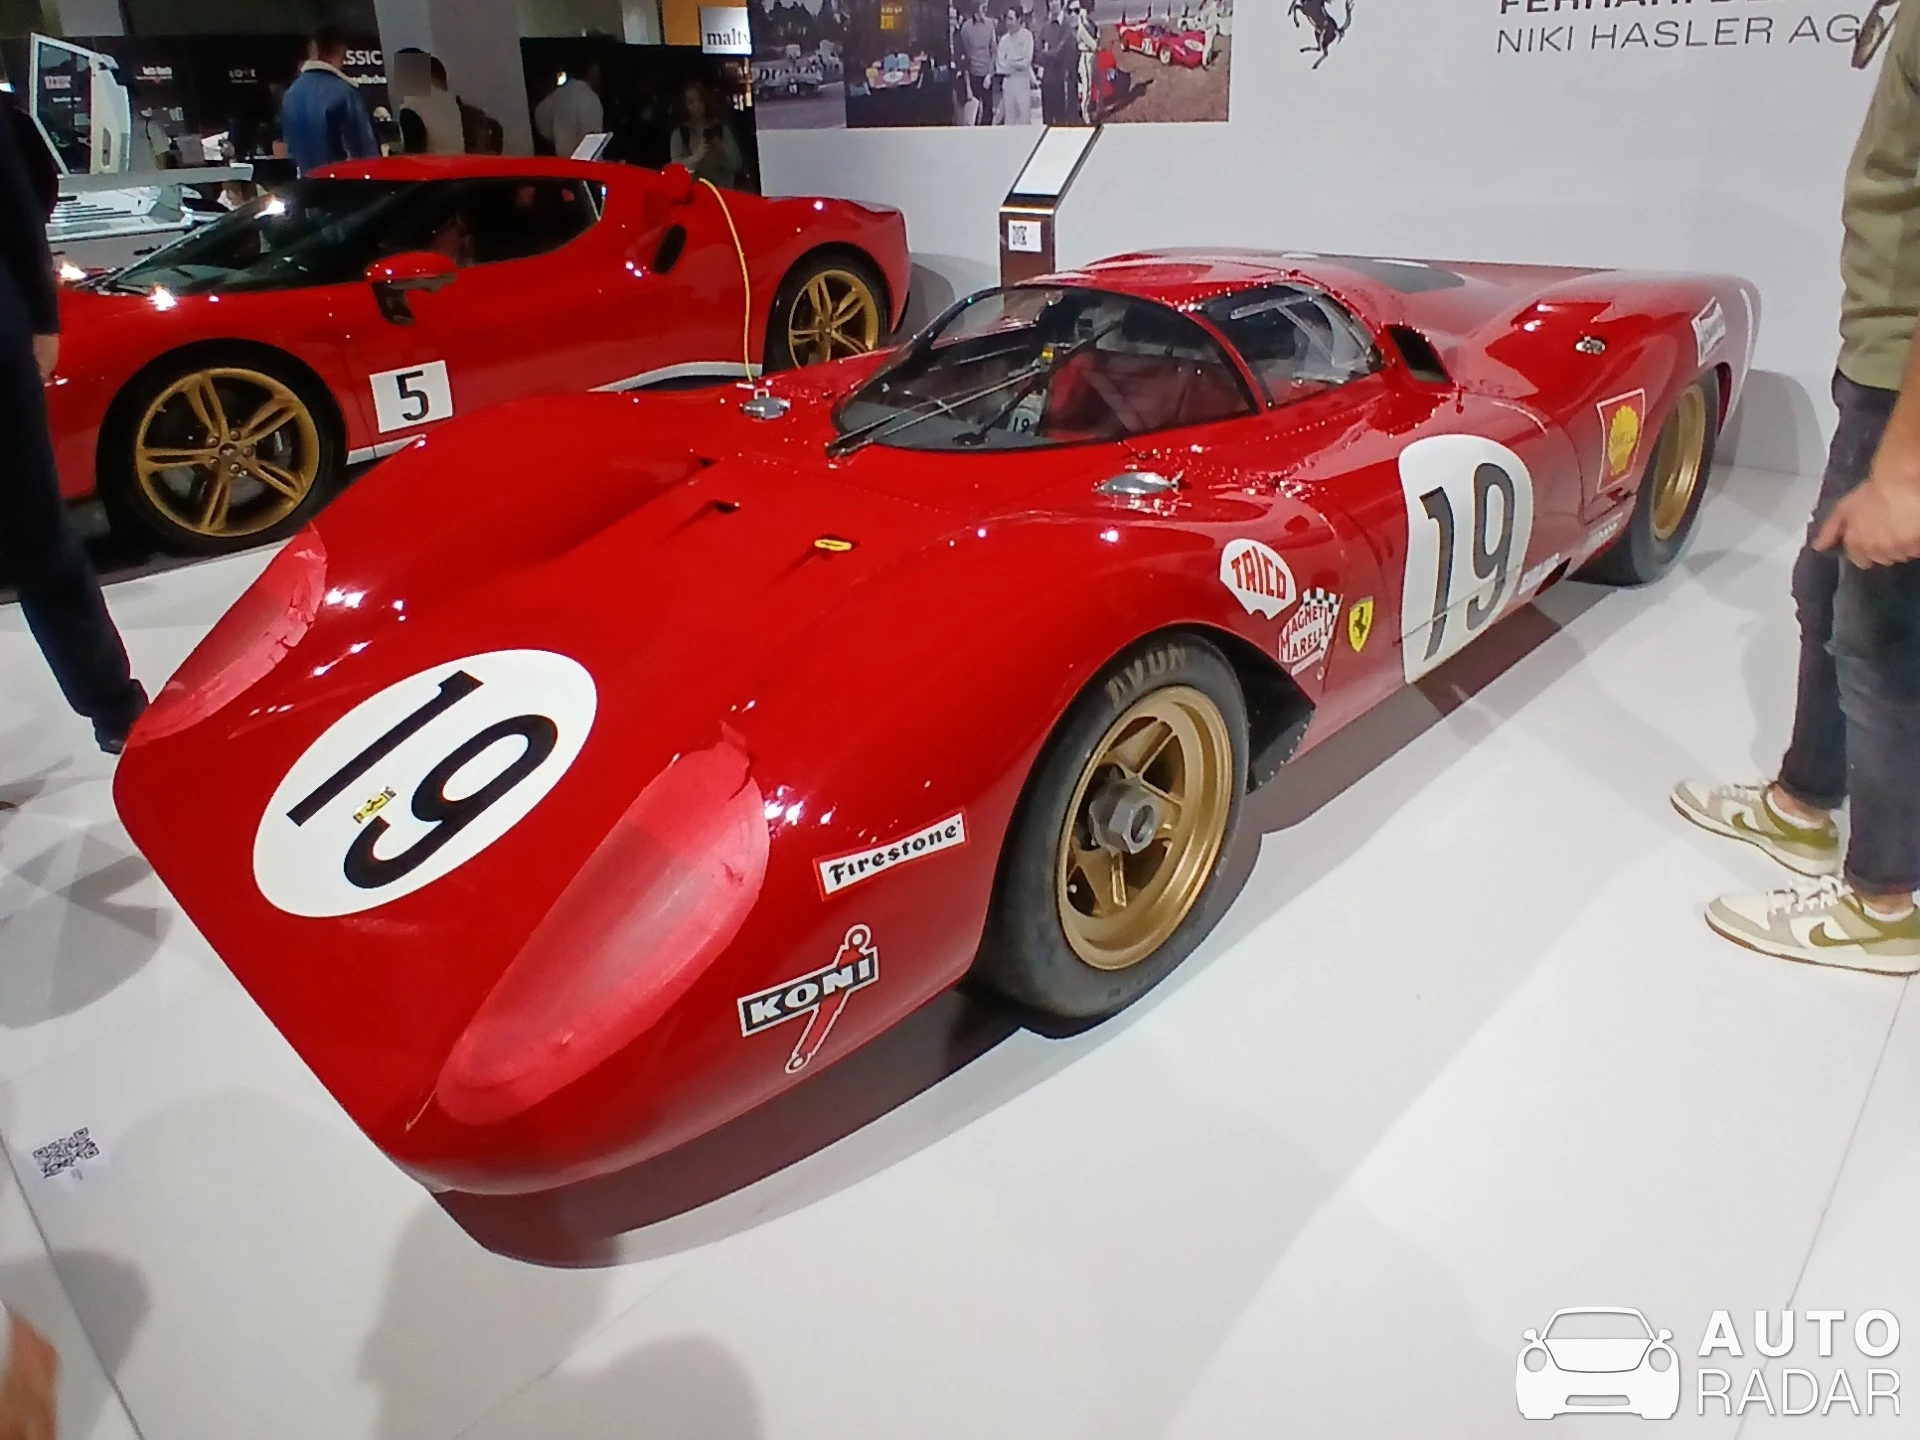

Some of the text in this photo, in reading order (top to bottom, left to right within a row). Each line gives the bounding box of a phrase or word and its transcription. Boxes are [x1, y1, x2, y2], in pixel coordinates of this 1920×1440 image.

[343, 50, 383, 66] SSIC
[1497, 13, 1861, 54] NIKI HASLER AG
[396, 370, 430, 421] 5
[1230, 546, 1287, 601] TRICO
[1419, 462, 1515, 662] 19
[286, 670, 558, 889] 19
[828, 823, 959, 887] Firestone
[750, 958, 871, 1025] KONI
